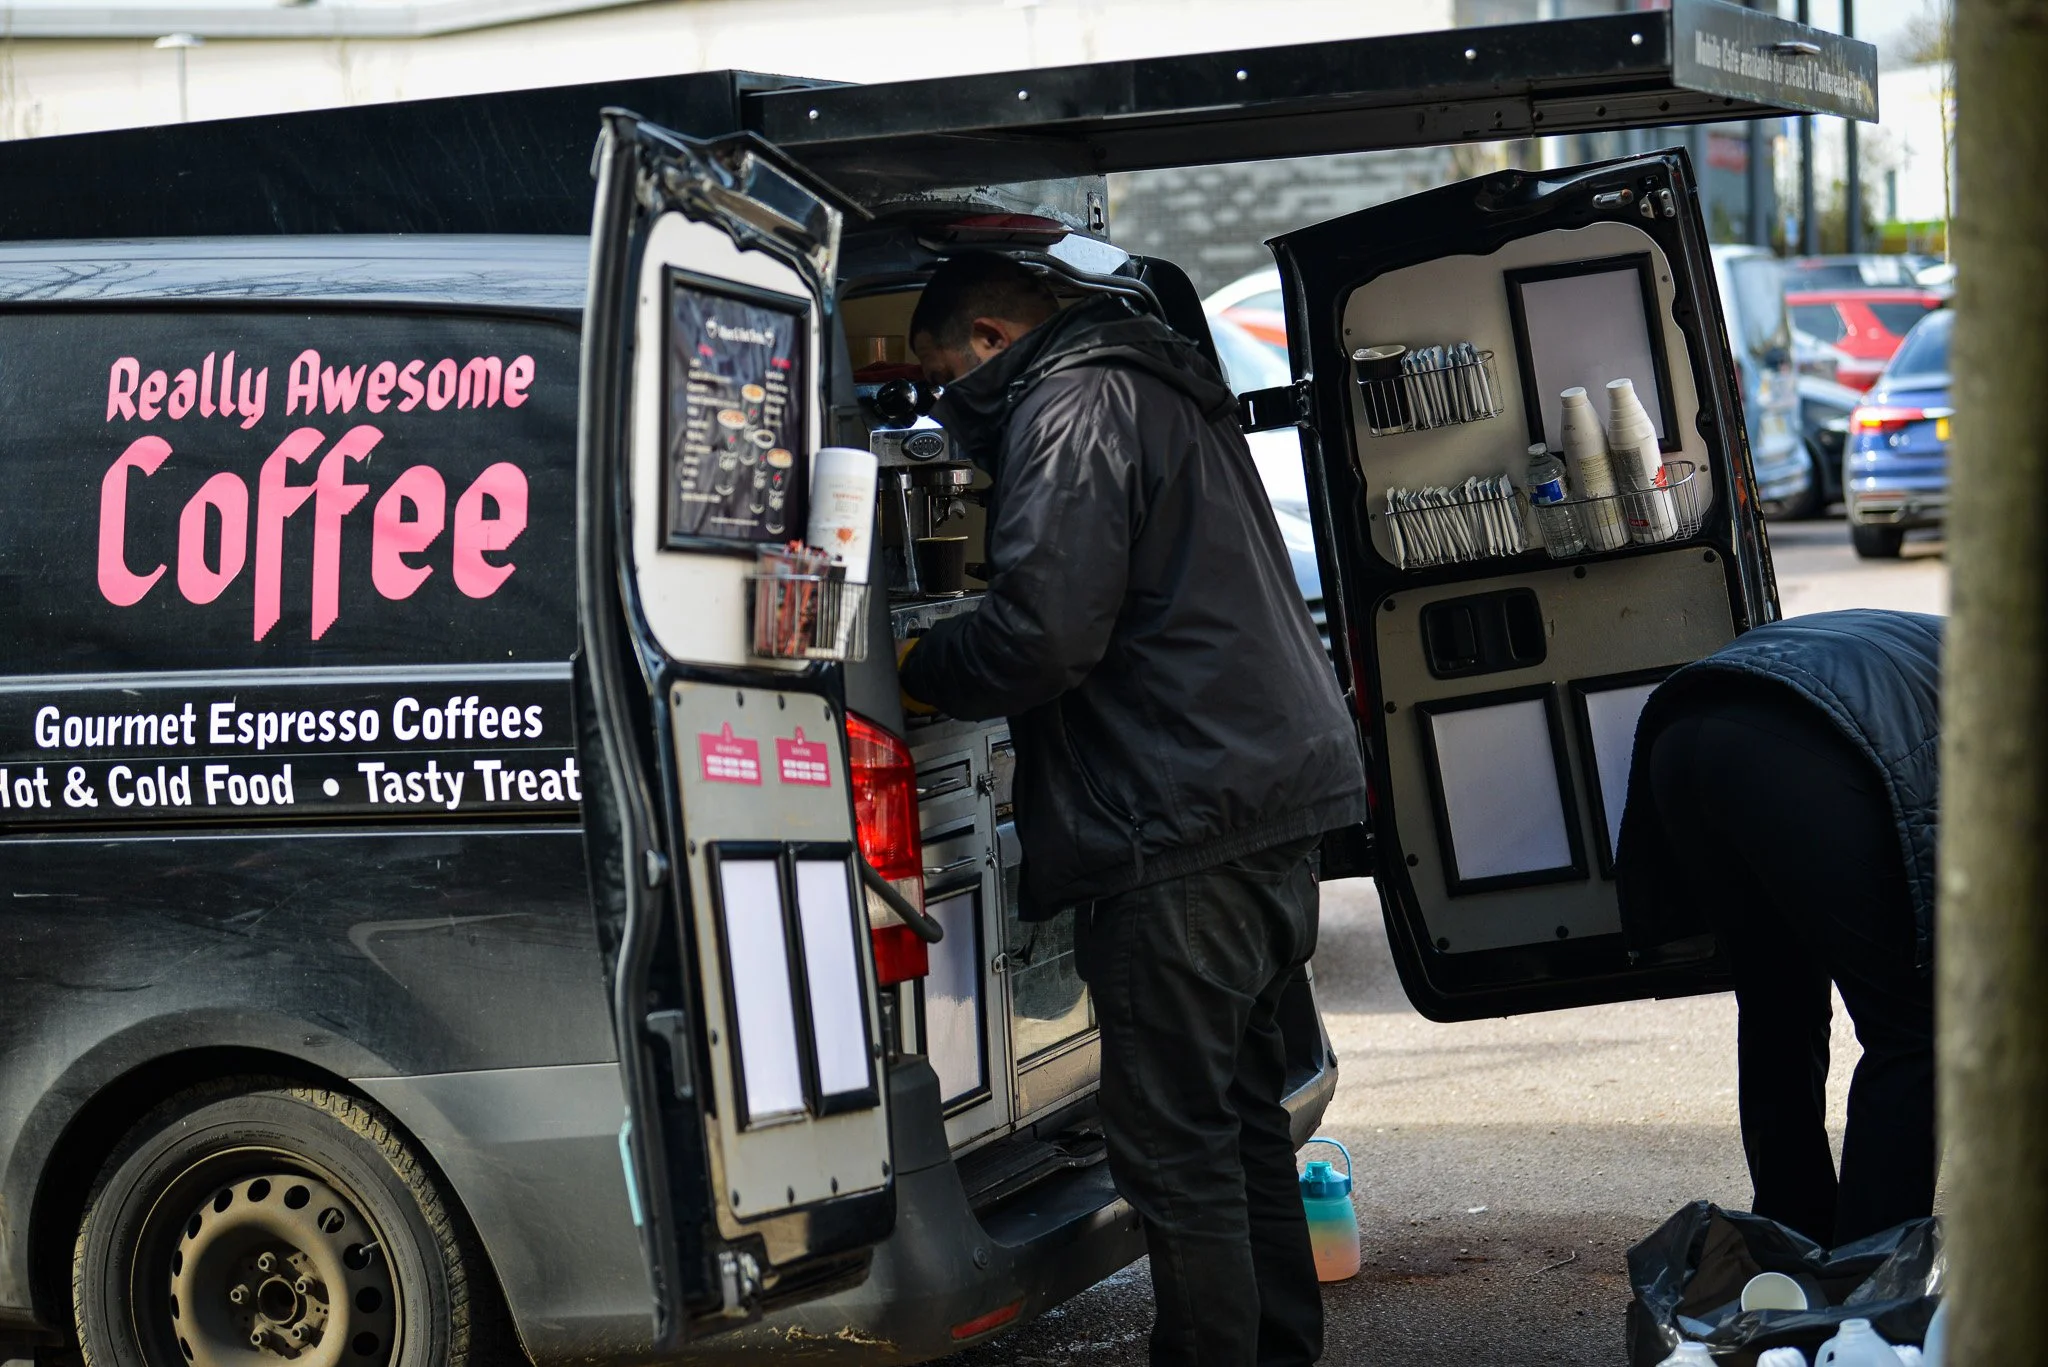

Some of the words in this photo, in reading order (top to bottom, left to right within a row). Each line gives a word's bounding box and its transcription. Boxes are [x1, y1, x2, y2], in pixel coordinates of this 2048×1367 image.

[1695, 30, 1721, 69] Mobile
[1740, 44, 1771, 81] available
[1773, 53, 1783, 84] for
[1785, 61, 1806, 89] events
[106, 351, 269, 430] Really
[285, 349, 535, 417] Awesome
[97, 421, 529, 642] Coffee
[35, 702, 197, 748] Gourmet
[209, 702, 380, 750] Espresso
[392, 695, 543, 741] Coffees
[63, 766, 99, 808] &
[108, 765, 192, 807] Cold
[204, 763, 295, 806] Food
[357, 760, 465, 810] Tasty
